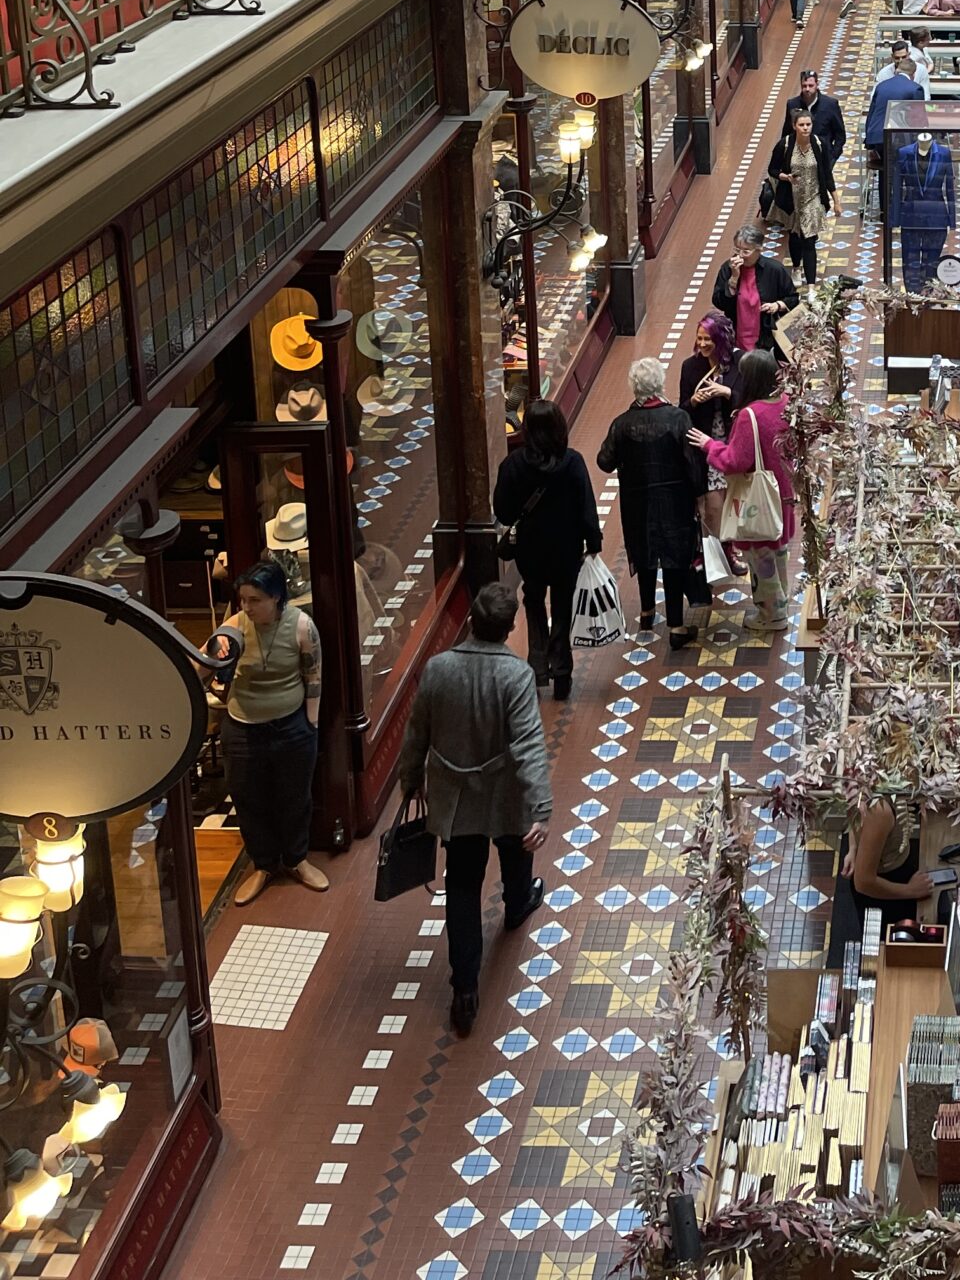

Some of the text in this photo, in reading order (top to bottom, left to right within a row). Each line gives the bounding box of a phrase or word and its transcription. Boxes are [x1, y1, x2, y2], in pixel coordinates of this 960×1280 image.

[537, 28, 630, 57] DÉCLIC
[579, 93, 592, 105] 10
[33, 724, 172, 740] HATTERS
[42, 817, 59, 839] 8
